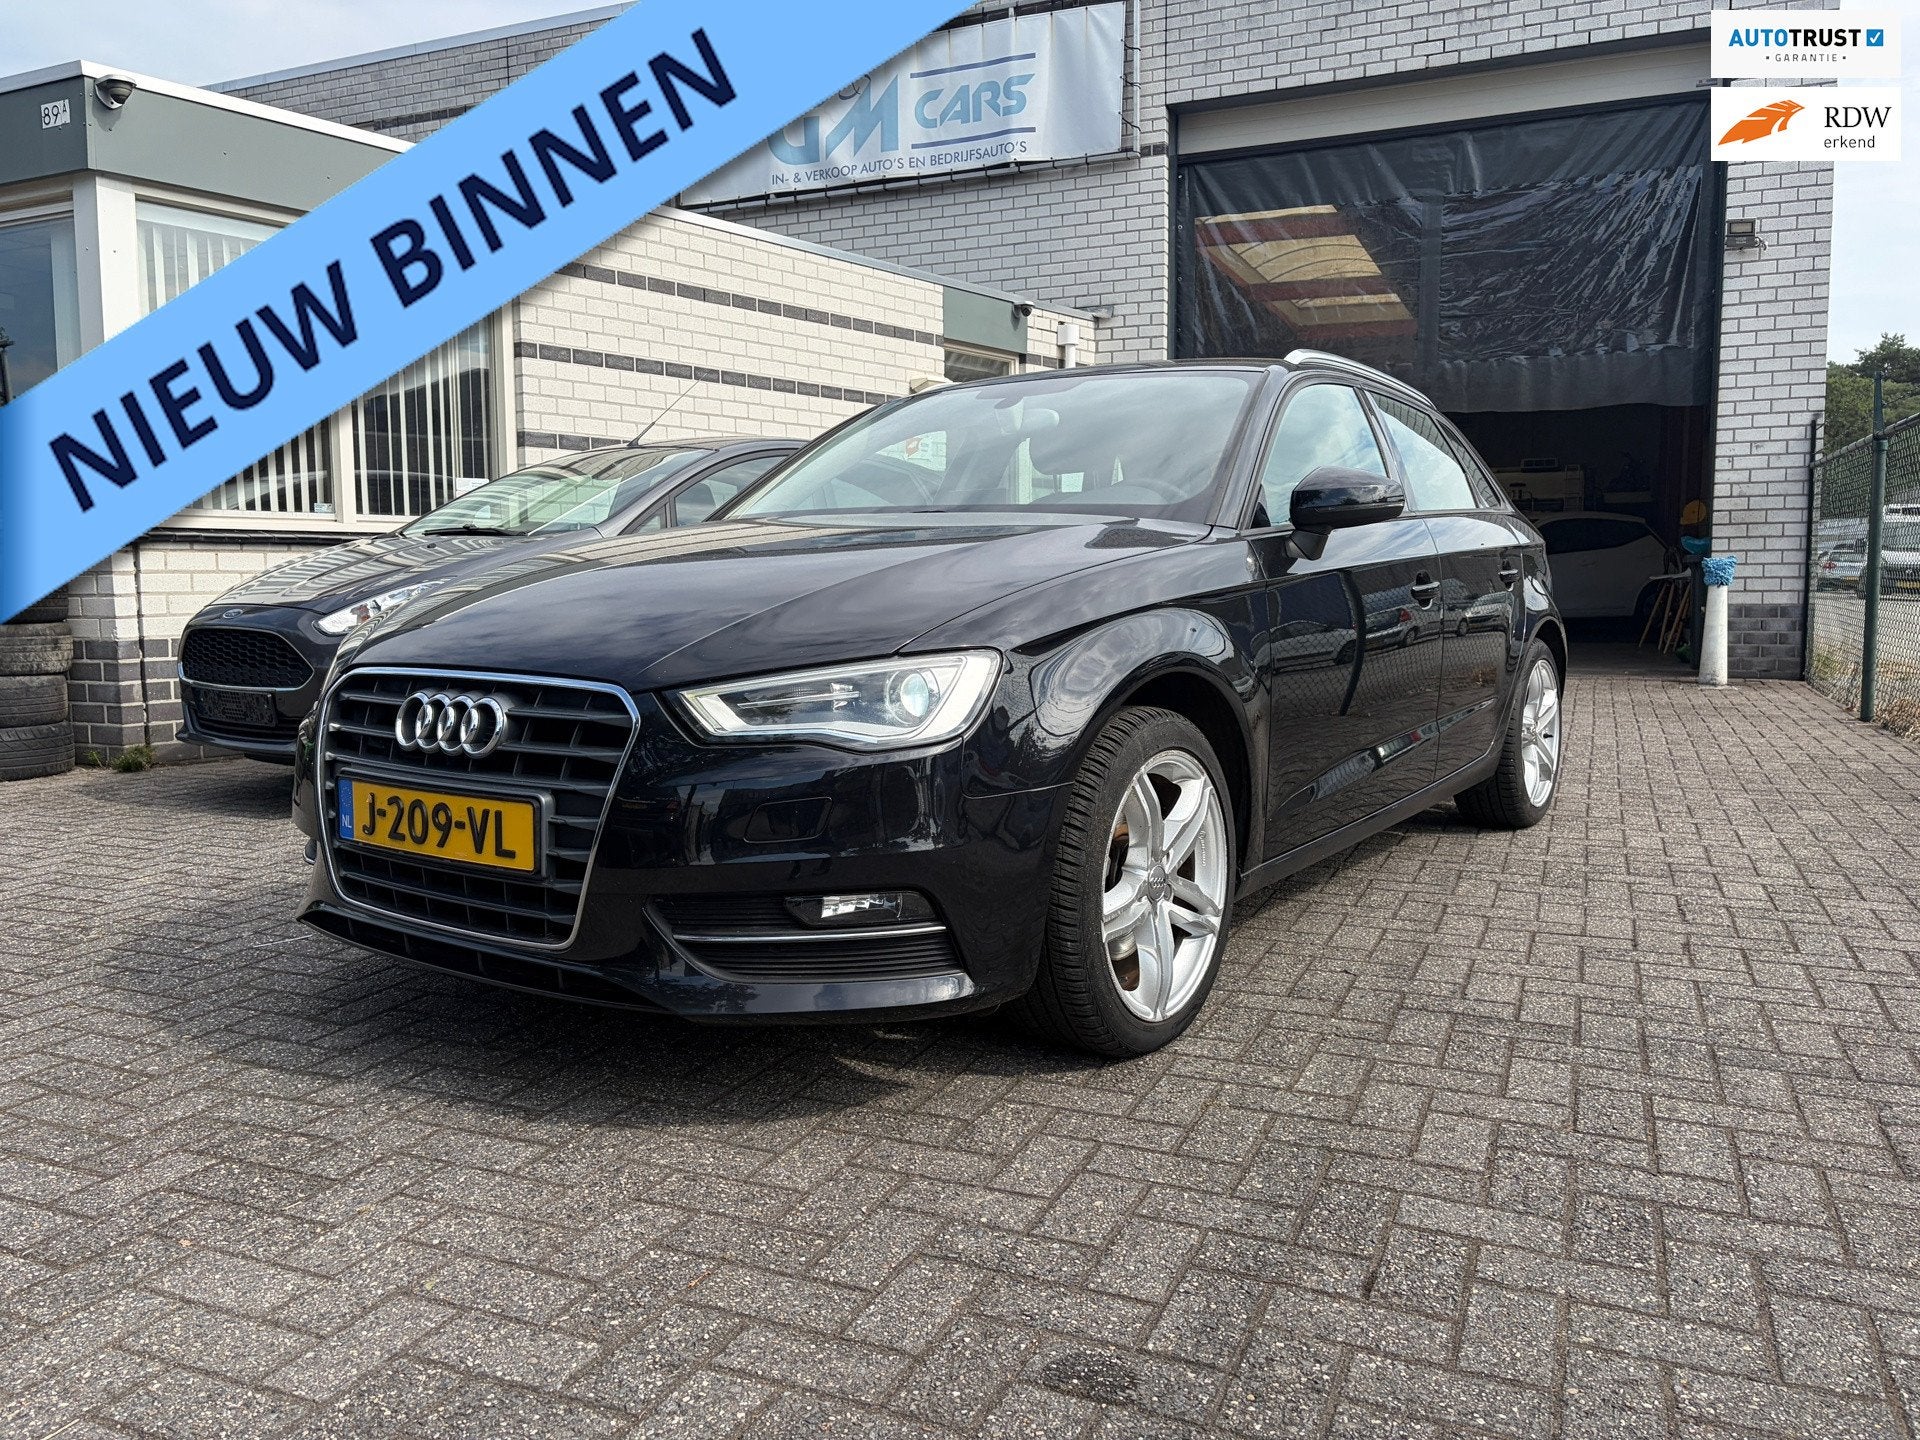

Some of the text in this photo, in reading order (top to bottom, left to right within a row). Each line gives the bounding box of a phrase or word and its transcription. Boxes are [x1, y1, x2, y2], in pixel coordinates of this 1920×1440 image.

[914, 73, 1036, 129] CARS
[771, 141, 1027, 185] IN- & VERKOOP AUTO'S EN BEDRIJFSAUTO'S
[341, 814, 353, 829] NL
[361, 791, 516, 860] J-209-VL
